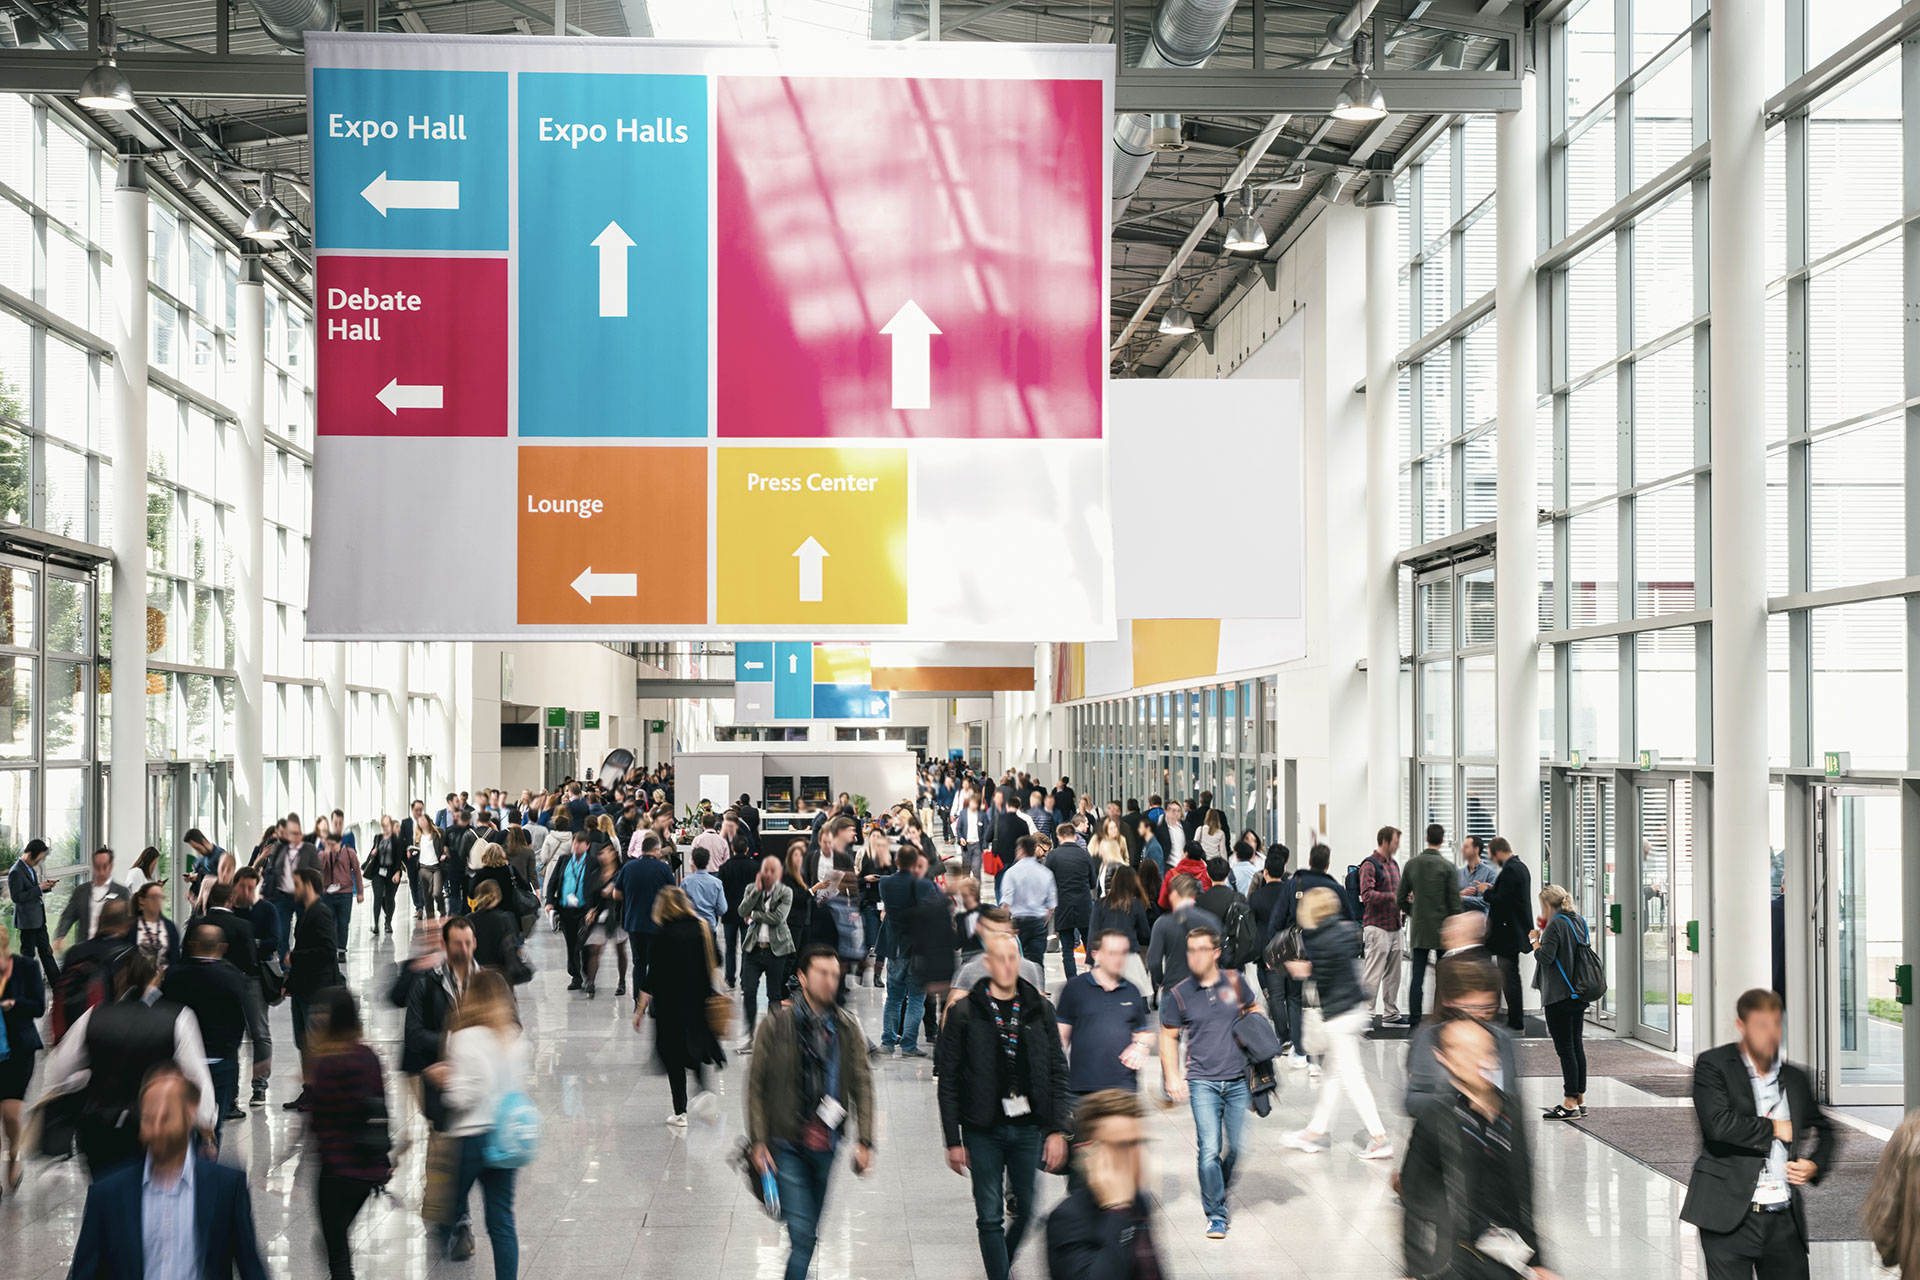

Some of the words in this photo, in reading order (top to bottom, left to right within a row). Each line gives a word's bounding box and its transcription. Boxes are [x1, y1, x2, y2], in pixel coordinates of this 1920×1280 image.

[329, 113, 399, 146] Expo
[408, 114, 467, 141] Hall
[539, 117, 607, 150] Expo
[616, 117, 689, 144] Halls
[328, 287, 422, 311] Debate
[328, 317, 381, 341] Hall
[747, 472, 802, 492] Press
[806, 472, 879, 492] Center
[527, 494, 604, 519] Lounge
